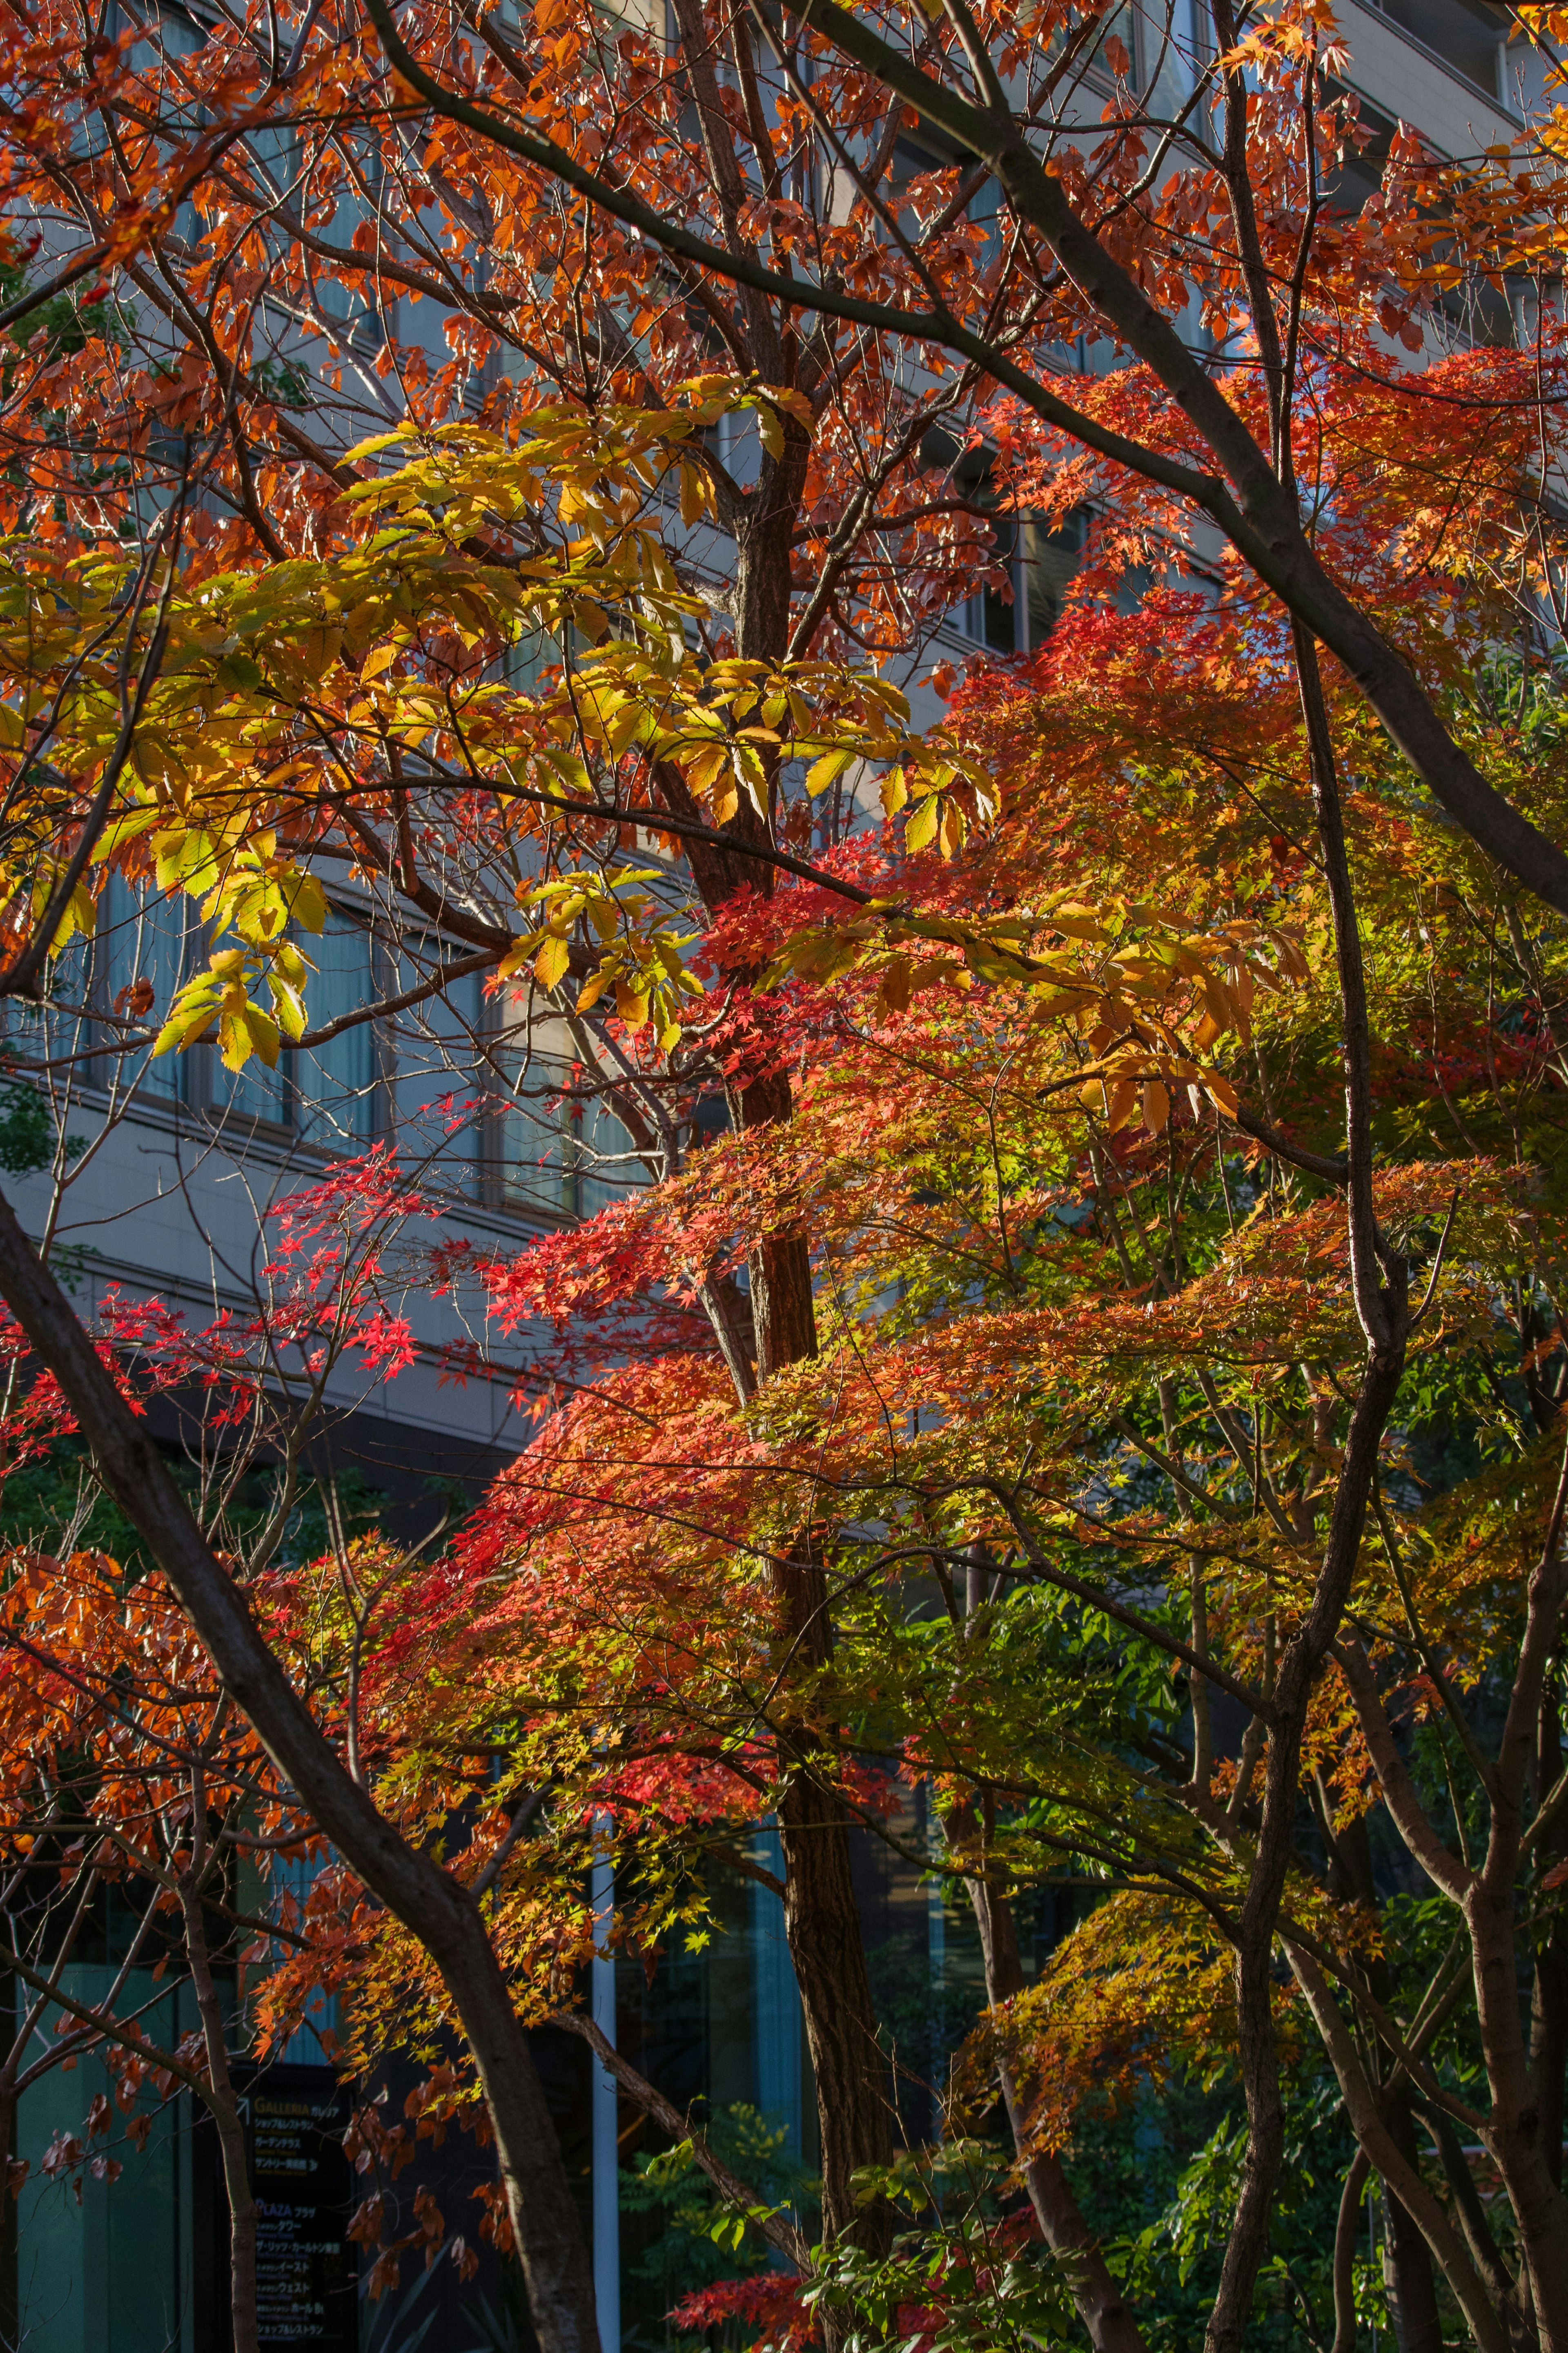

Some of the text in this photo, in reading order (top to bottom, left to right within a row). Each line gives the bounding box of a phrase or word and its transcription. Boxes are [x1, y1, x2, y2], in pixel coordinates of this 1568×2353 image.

[255, 2096, 309, 2116] GALLERIA
[255, 2136, 301, 2149] ガーデンテラス
[255, 2198, 316, 2219] PLAZA プラザ
